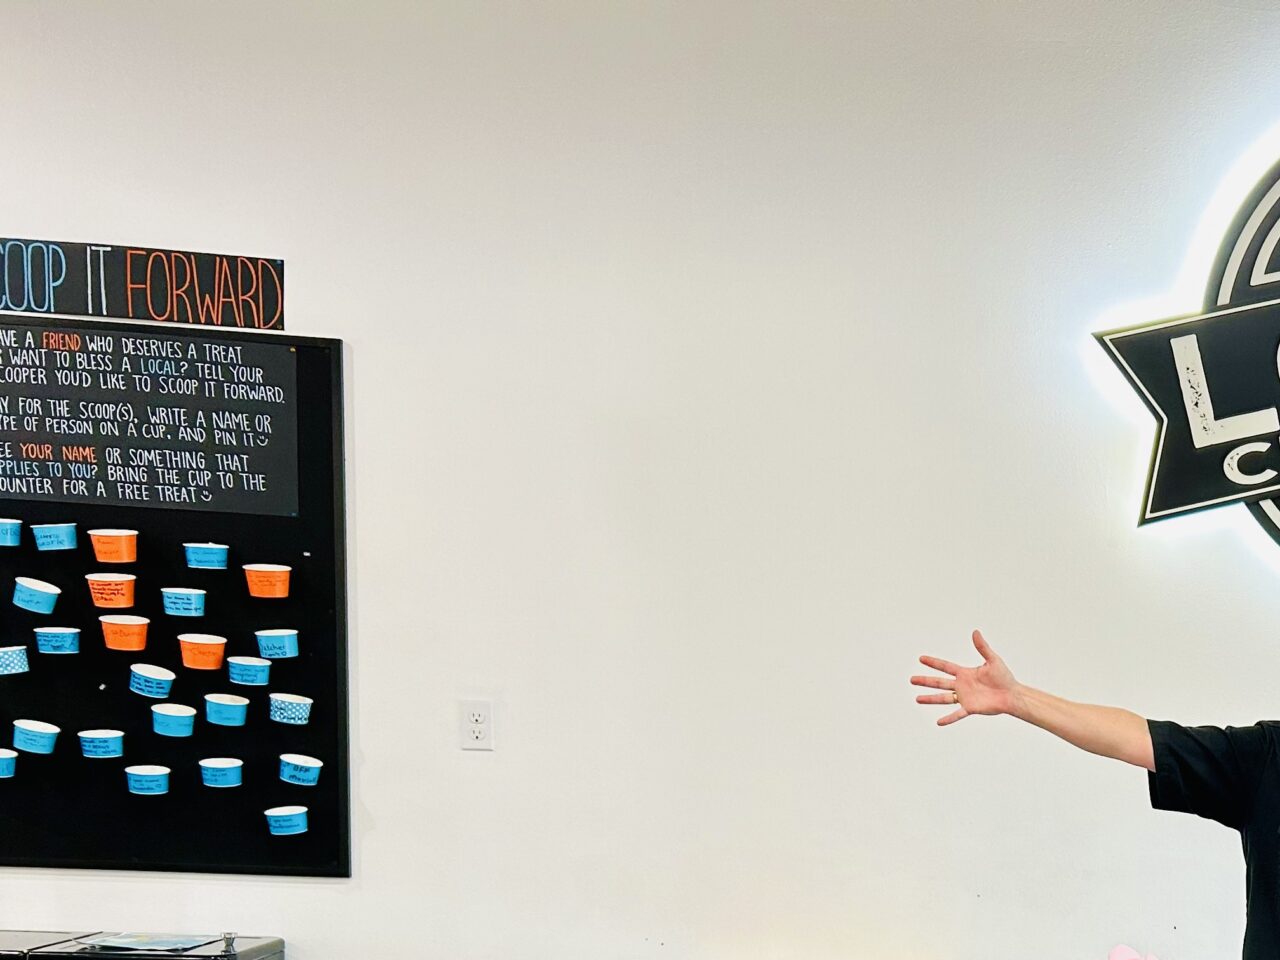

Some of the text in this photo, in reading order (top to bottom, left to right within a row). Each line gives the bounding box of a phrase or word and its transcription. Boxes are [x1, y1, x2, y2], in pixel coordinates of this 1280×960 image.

[86, 245, 112, 316] IT
[126, 249, 282, 330] FORWARD
[25, 330, 35, 349] A
[42, 331, 82, 352] FRIEND
[85, 334, 114, 353] WHO
[121, 337, 183, 359] DESERVES
[187, 342, 198, 360] A
[202, 343, 243, 365] TREAT
[8, 348, 49, 368] WANT
[53, 350, 70, 369] TO
[76, 352, 113, 371] BLESS
[121, 356, 132, 374] A
[140, 358, 189, 377] LOCAL?
[195, 362, 225, 381] TELL
[229, 364, 264, 384] YOUR
[55, 368, 92, 389] YOU'D
[99, 372, 127, 391] LIKE
[132, 374, 151, 393] TO
[158, 376, 199, 396] SCOOP
[204, 380, 217, 398] IT
[223, 382, 286, 404] FORWARD.
[18, 397, 43, 416] FOR
[46, 398, 71, 418] THE
[146, 405, 189, 427] WRITE
[196, 410, 207, 428] A
[211, 410, 251, 432] NAME
[255, 414, 272, 434] OR
[23, 416, 40, 433] OF
[45, 417, 94, 436] PERSON
[99, 421, 120, 437] ON
[127, 422, 138, 438] A
[178, 426, 206, 443] AND
[213, 429, 237, 447] PIN
[20, 442, 53, 461] YOUR
[61, 445, 98, 463] NAME
[105, 447, 122, 465] OR
[129, 448, 206, 470] SOMETHING
[214, 453, 249, 472] THAT
[46, 461, 62, 478] TO
[67, 462, 98, 479] YOU?
[107, 464, 148, 483] BRING
[155, 468, 181, 485] THE
[188, 470, 212, 488] CUP
[216, 471, 234, 490] TO
[238, 472, 267, 492] THE
[63, 478, 89, 497] FOR
[96, 480, 107, 498] A
[117, 482, 150, 501] FREE
[154, 485, 197, 503] TREAT
